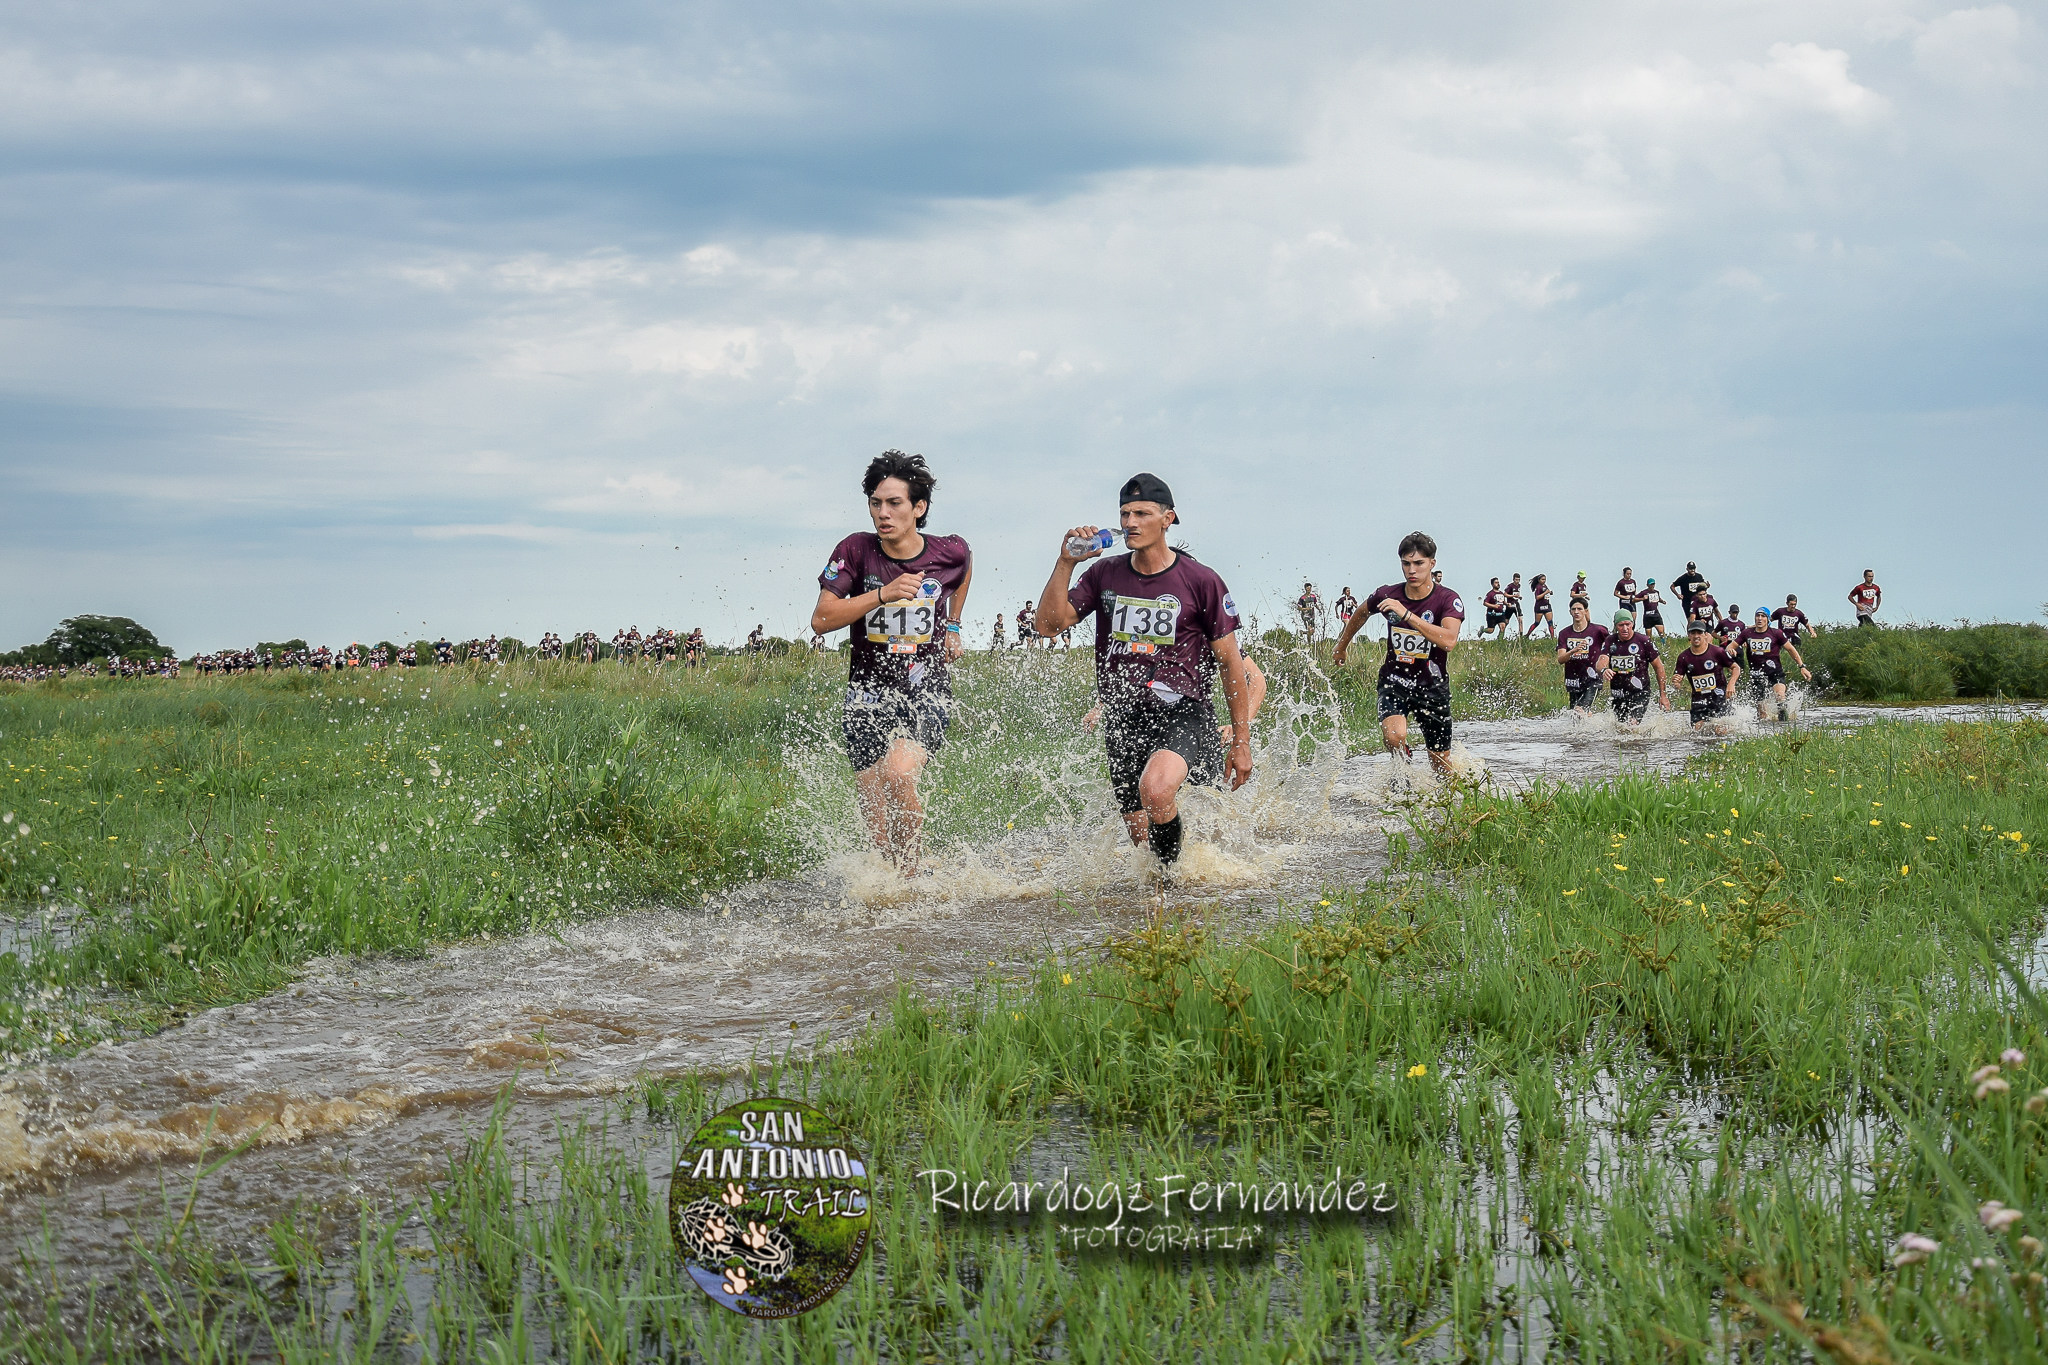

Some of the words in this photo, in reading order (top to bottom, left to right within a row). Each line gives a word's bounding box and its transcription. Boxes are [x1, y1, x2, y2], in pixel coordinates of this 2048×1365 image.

[868, 607, 932, 635] 413
[1115, 605, 1173, 637] 138
[1393, 632, 1430, 654] 364
[1751, 641, 1770, 650] 337
[1612, 658, 1634, 669] 245
[1693, 676, 1715, 689] 390
